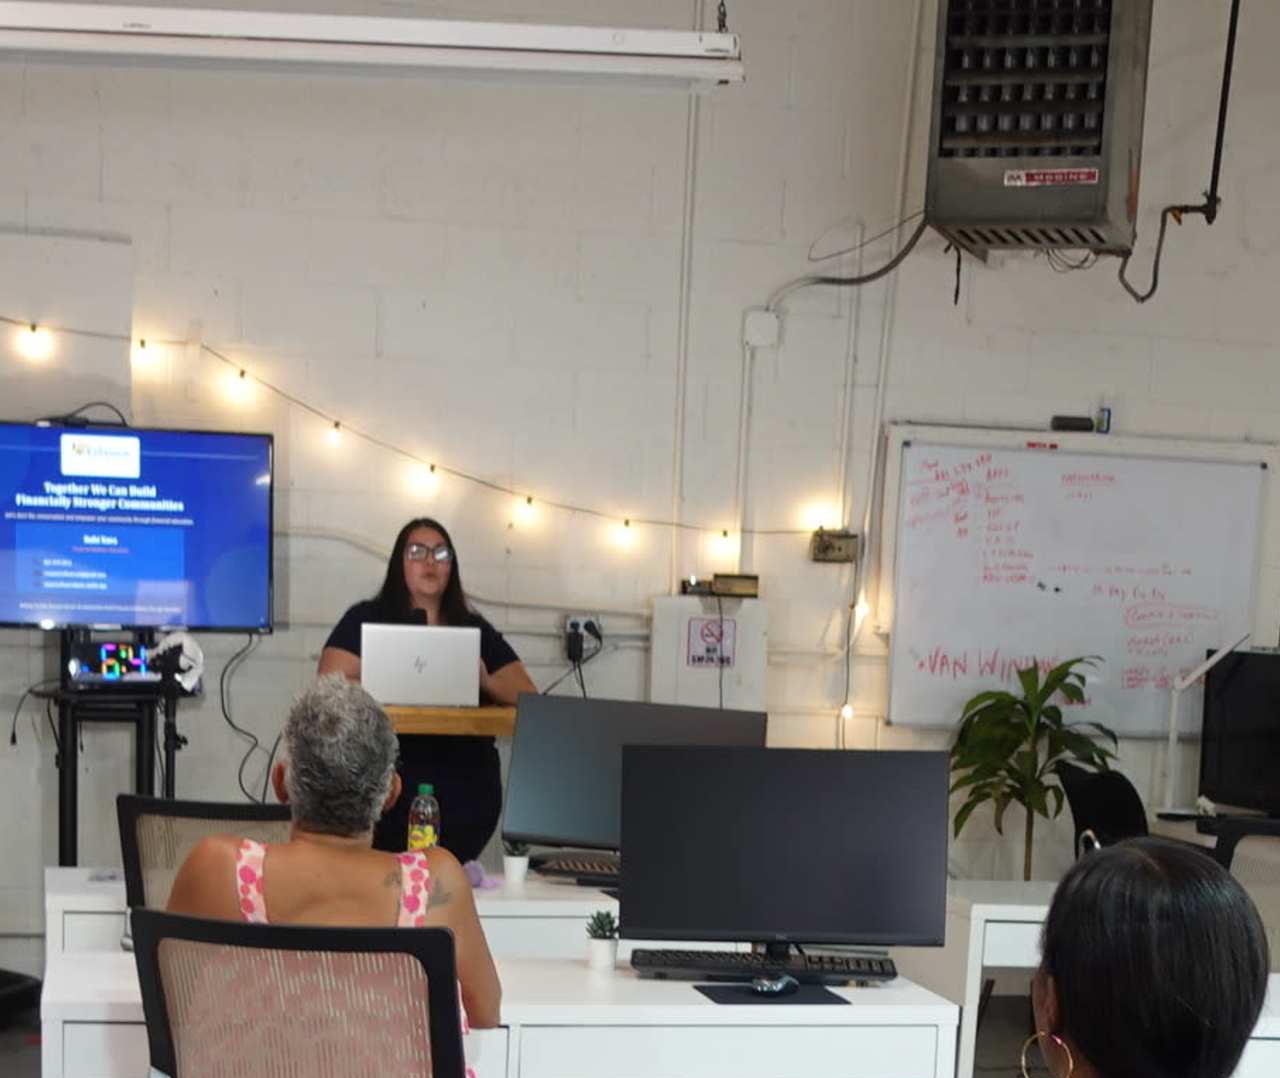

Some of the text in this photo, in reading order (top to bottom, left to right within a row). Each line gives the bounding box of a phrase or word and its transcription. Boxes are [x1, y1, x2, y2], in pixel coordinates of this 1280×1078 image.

[43, 481, 157, 498] Together We Can Build
[15, 493, 185, 512] Financially Stronger Communities
